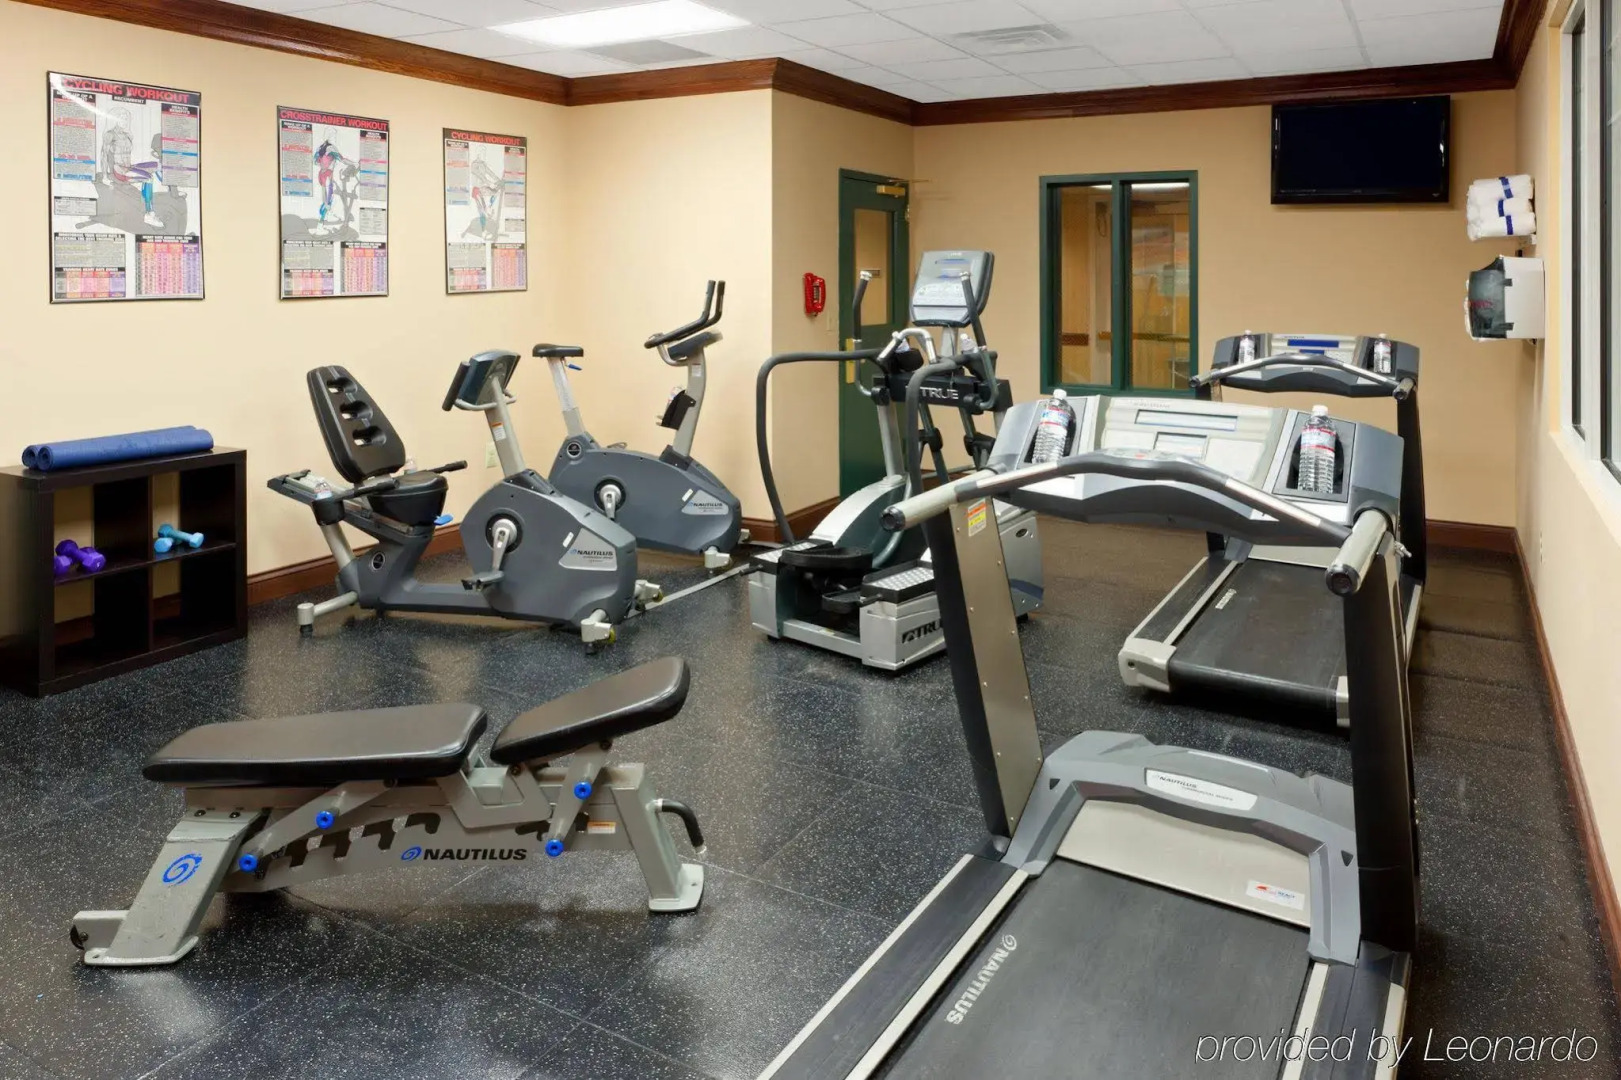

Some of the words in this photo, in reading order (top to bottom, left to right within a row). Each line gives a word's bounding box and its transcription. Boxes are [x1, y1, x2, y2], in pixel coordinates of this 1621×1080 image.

[63, 78, 122, 95] CYCLING
[126, 85, 189, 103] WORKOUT
[280, 110, 346, 126] CROSSTRAINER
[348, 118, 388, 131] WORKOUT
[451, 131, 483, 141] CYCLING
[485, 134, 521, 145] WORKOUT
[920, 386, 959, 400] TRUE
[913, 620, 941, 638] TRU
[1159, 776, 1197, 788] NAUTILUS
[423, 848, 527, 860] NAUTILUS
[946, 947, 1009, 1024] NAUTILUS
